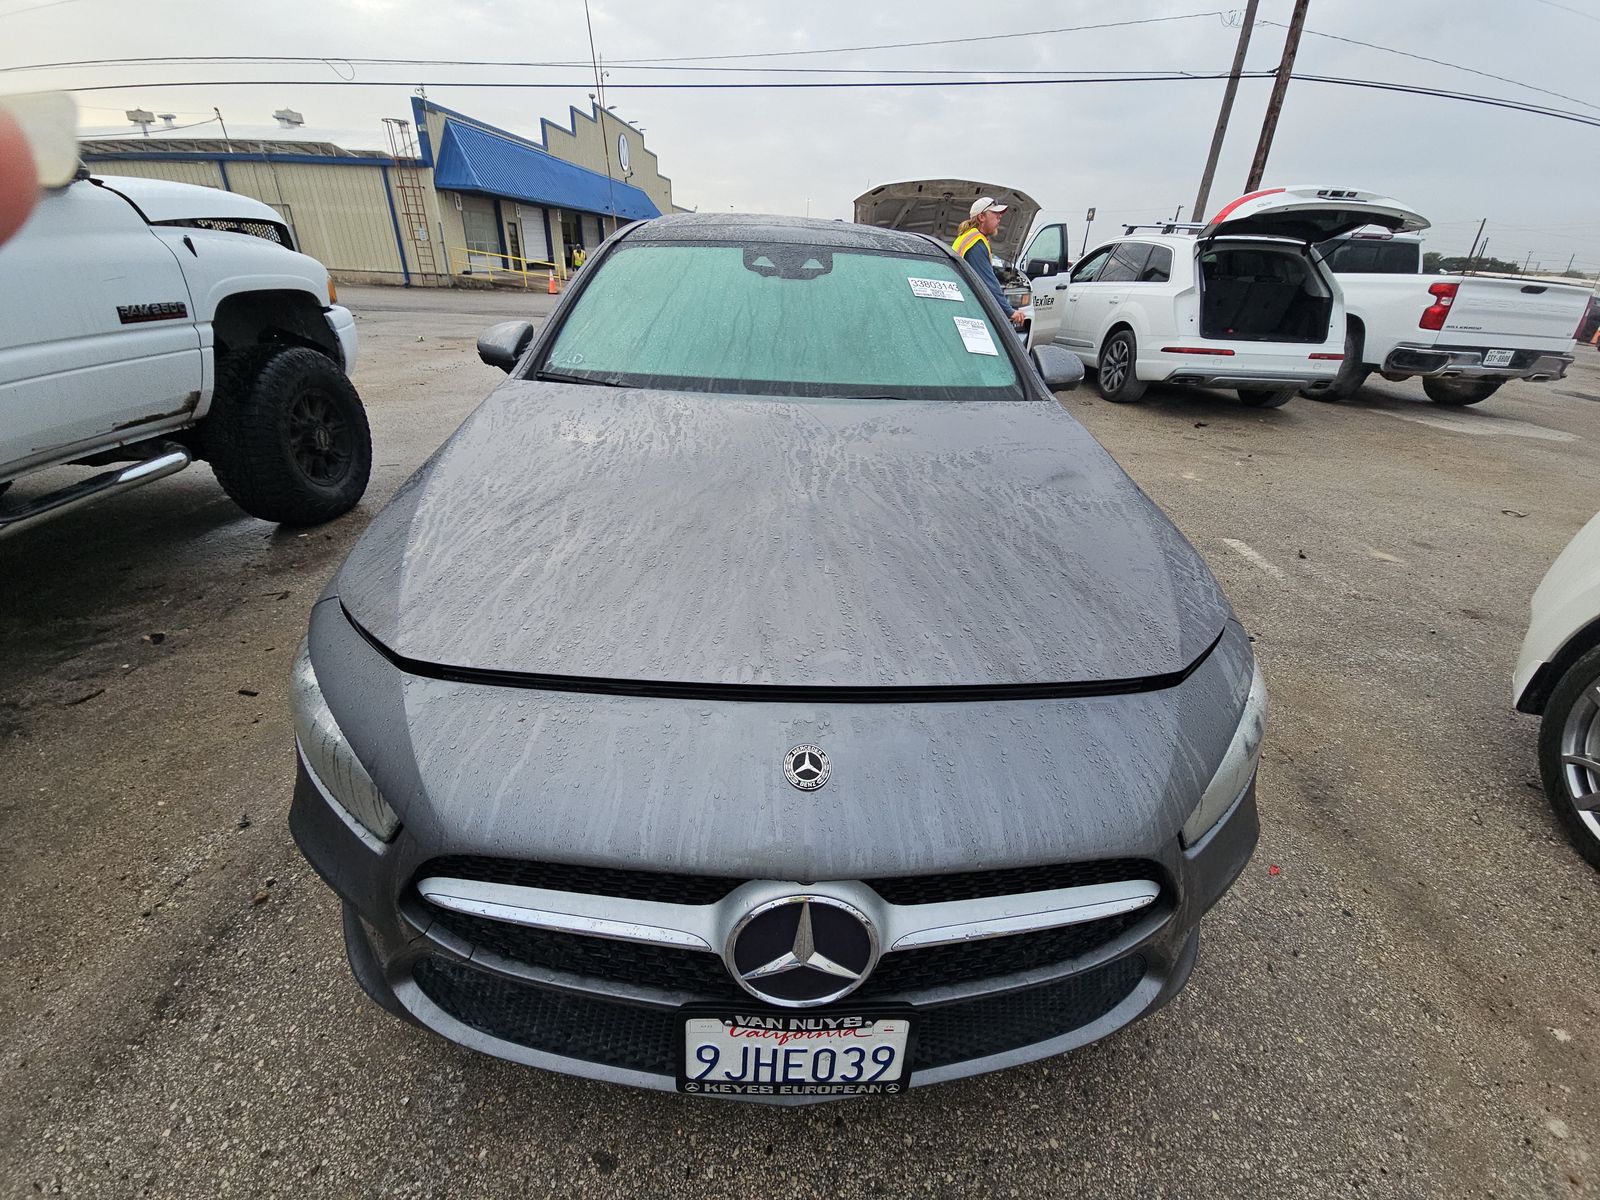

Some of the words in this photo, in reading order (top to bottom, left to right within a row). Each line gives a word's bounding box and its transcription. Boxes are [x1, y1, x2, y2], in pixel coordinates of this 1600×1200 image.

[119, 303, 150, 317] RAM
[734, 1015, 783, 1030] VAN
[789, 1016, 863, 1030] NUYS
[695, 1044, 896, 1083] 9JHE039
[704, 1083, 774, 1095] KEYES
[779, 1084, 882, 1095] EUROPEAN
